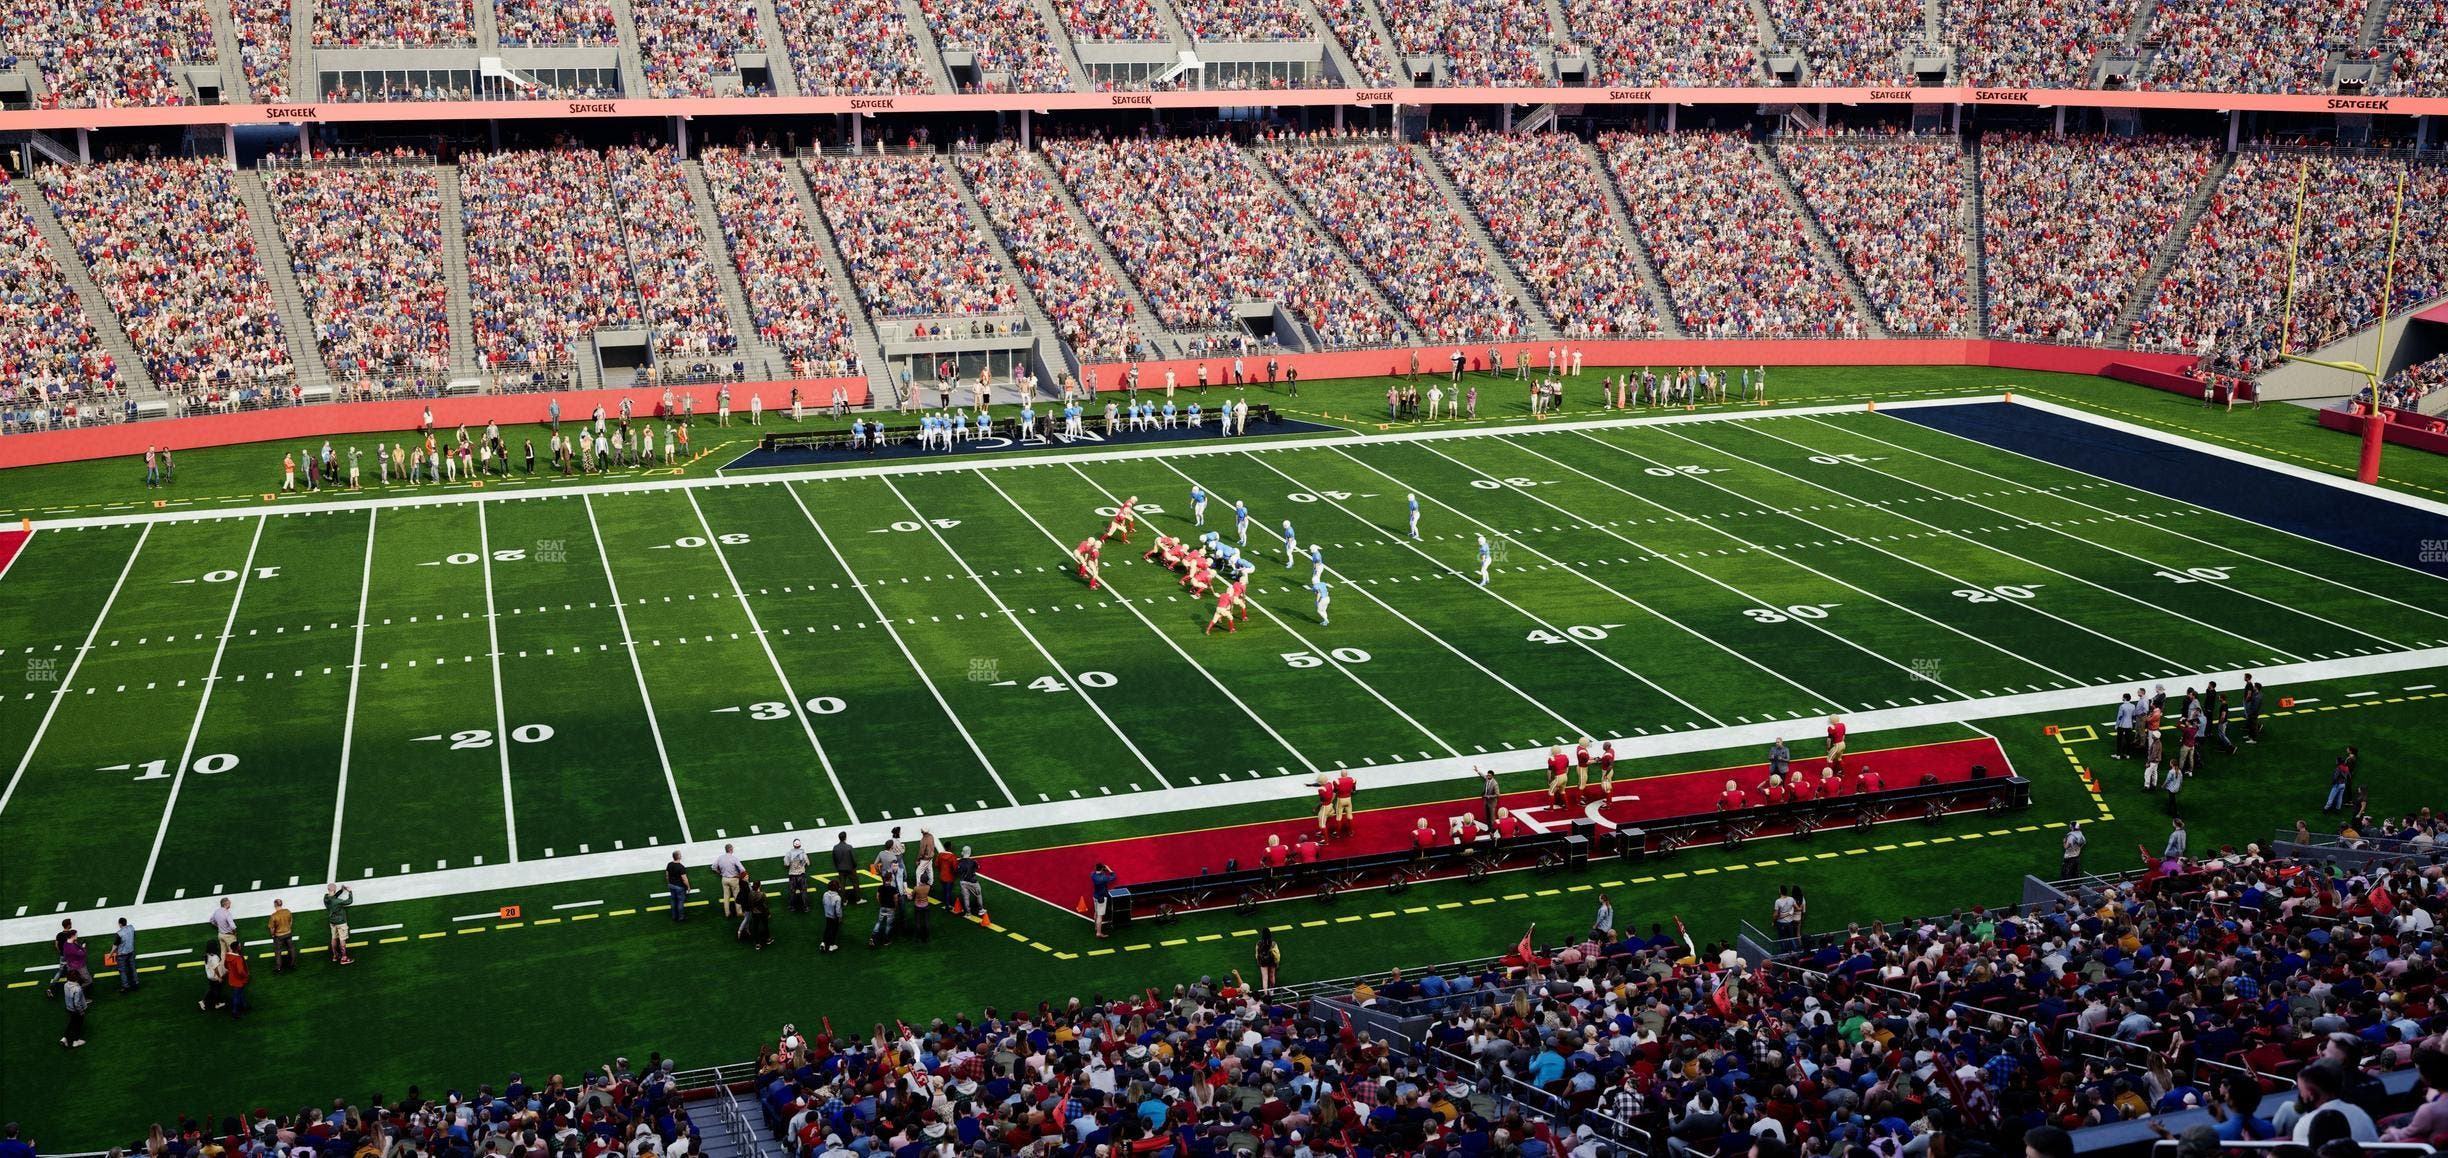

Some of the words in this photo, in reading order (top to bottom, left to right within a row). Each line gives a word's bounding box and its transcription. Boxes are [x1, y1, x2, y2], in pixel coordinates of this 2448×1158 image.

[1112, 95, 1152, 105] SEATGEEK
[1356, 91, 1393, 101] SEATGEEK
[1610, 90, 1651, 100] SEATGEEK
[1870, 90, 1912, 100] SEATGEEK
[1975, 91, 2028, 101] SEATGEEK
[569, 103, 616, 114] SEATGEEK
[850, 99, 894, 109] SEATGEEK
[2327, 99, 2389, 110] SEATGEEK
[266, 107, 316, 118] SEATGEEK
[1808, 452, 1869, 466] 10
[1644, 465, 1710, 477] 20
[1470, 478, 1537, 489] 30
[1287, 491, 1352, 502] 40
[1095, 504, 1165, 517] 50
[891, 519, 961, 531] 40
[676, 534, 750, 547] 30
[447, 549, 526, 564] 20
[203, 567, 280, 582] 10
[2154, 568, 2229, 583] 10
[1952, 586, 2035, 603] 20
[1743, 605, 1828, 623] 30
[1526, 626, 1606, 644] 40
[1280, 648, 1371, 667] 50
[1028, 672, 1118, 692] 40
[749, 697, 846, 720] 30
[450, 724, 554, 749] 20
[134, 754, 239, 780] 10
[505, 908, 516, 917] 20
